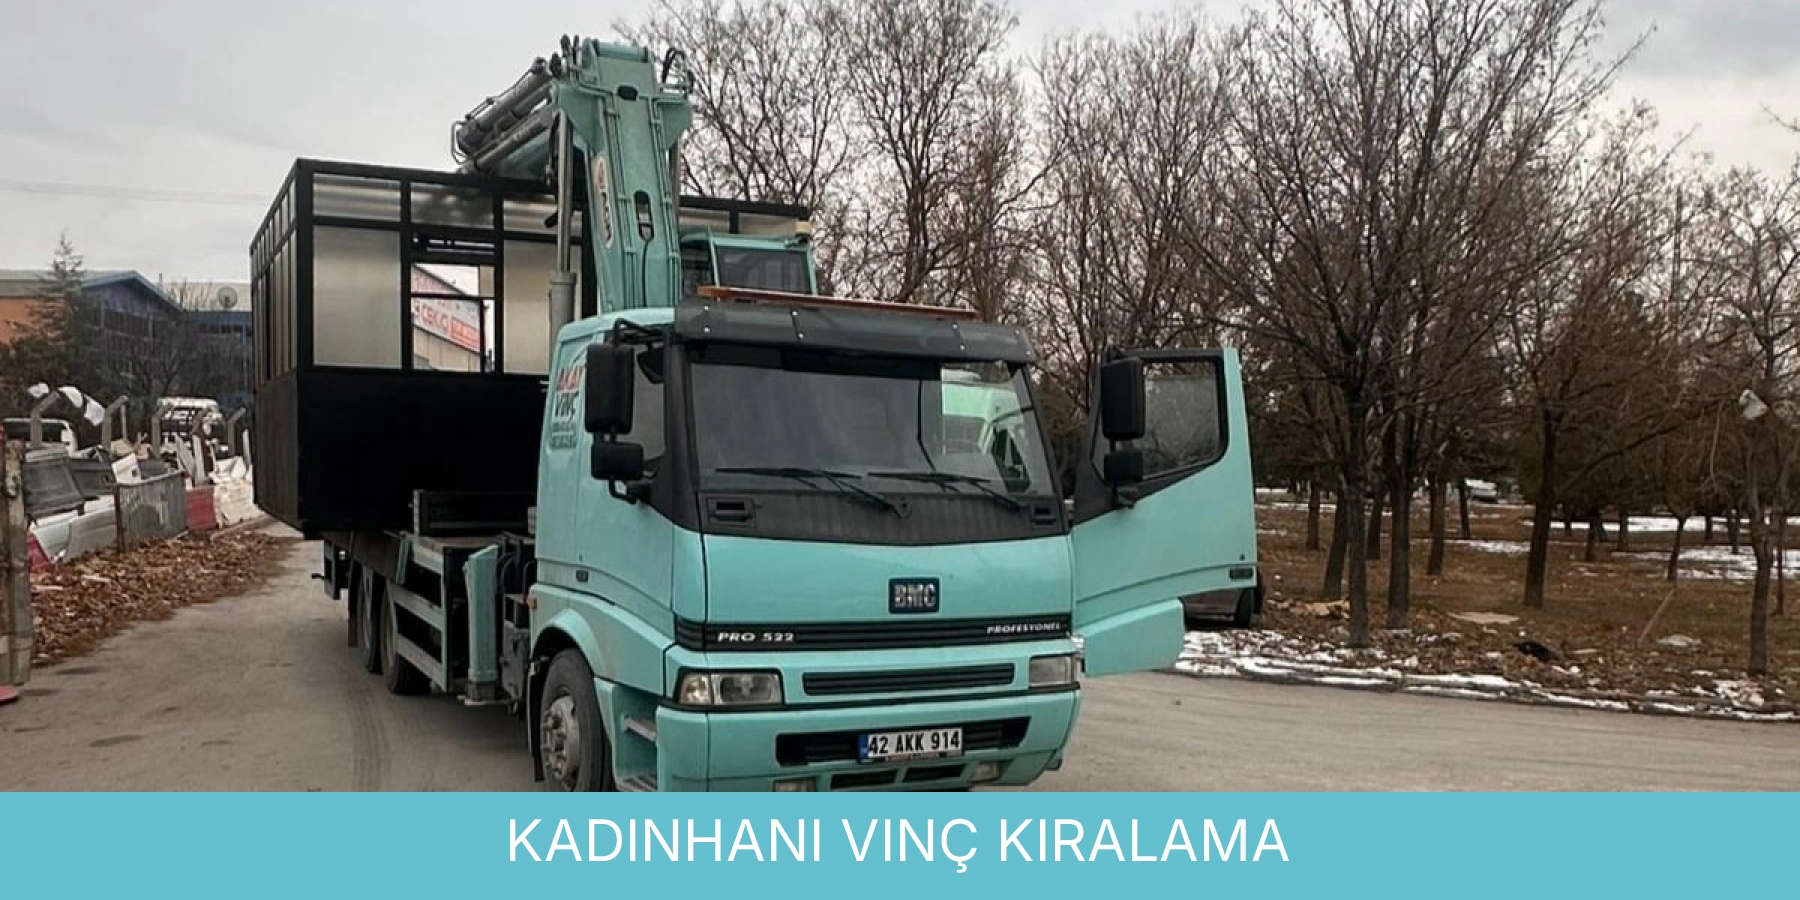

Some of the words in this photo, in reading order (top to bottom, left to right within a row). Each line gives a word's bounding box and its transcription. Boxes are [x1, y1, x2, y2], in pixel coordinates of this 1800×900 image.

[894, 583, 937, 607] BMC
[716, 631, 757, 643] PRO
[761, 631, 795, 643] 522
[986, 622, 1061, 635] PROFESYONEL
[868, 735, 889, 754] 42
[895, 733, 925, 753] AKK
[930, 730, 960, 750] 914
